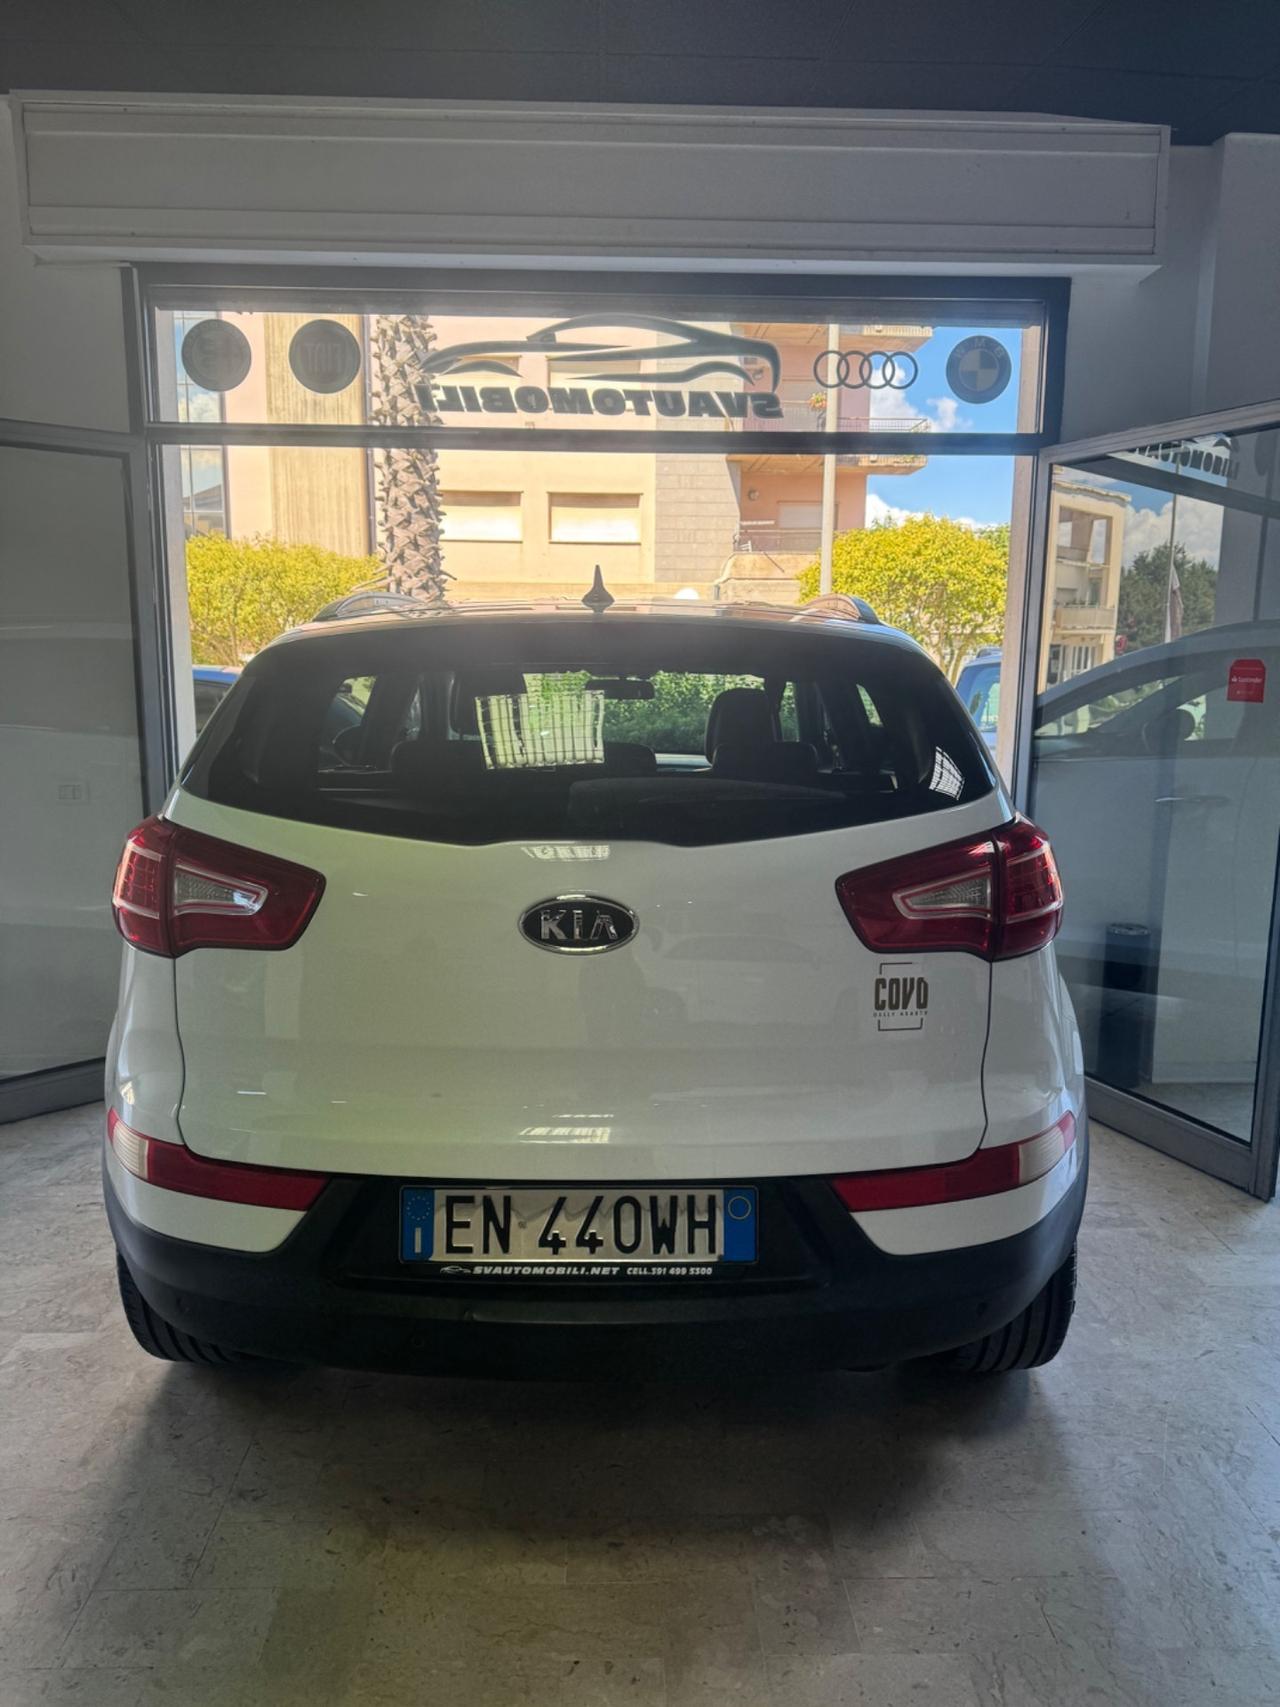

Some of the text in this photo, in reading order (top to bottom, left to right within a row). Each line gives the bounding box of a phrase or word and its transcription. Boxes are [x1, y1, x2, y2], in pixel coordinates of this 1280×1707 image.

[540, 909, 619, 940] KIA
[874, 976, 929, 1011] COVO
[445, 1194, 716, 1256] EN 440WH
[472, 1266, 621, 1275] SVAUTOMOBILI.NET
